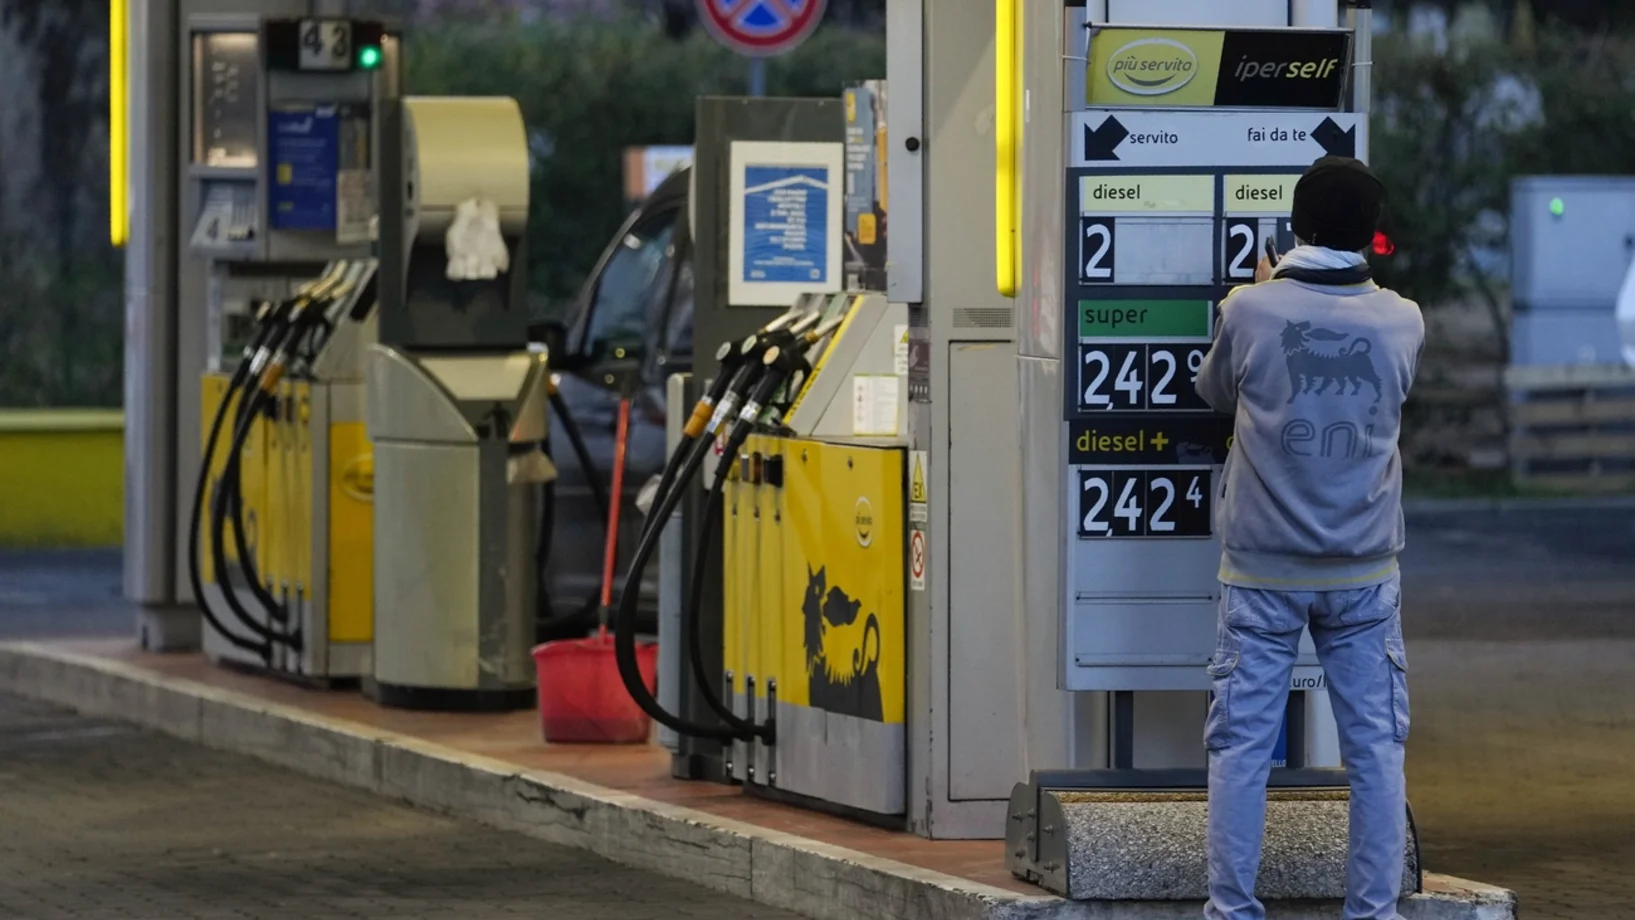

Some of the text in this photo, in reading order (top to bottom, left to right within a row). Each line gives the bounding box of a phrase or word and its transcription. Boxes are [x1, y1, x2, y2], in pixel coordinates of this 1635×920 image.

[1113, 55, 1193, 74] più servito
[1234, 54, 1339, 82] iperself
[1129, 131, 1179, 145] servito
[1247, 127, 1307, 142] fai da te
[1093, 184, 1141, 200] diesel
[1235, 185, 1283, 201] diesel
[1085, 223, 1111, 278] 2
[1229, 223, 1254, 278] 2
[1084, 304, 1148, 328] super
[1281, 405, 1378, 458] eni
